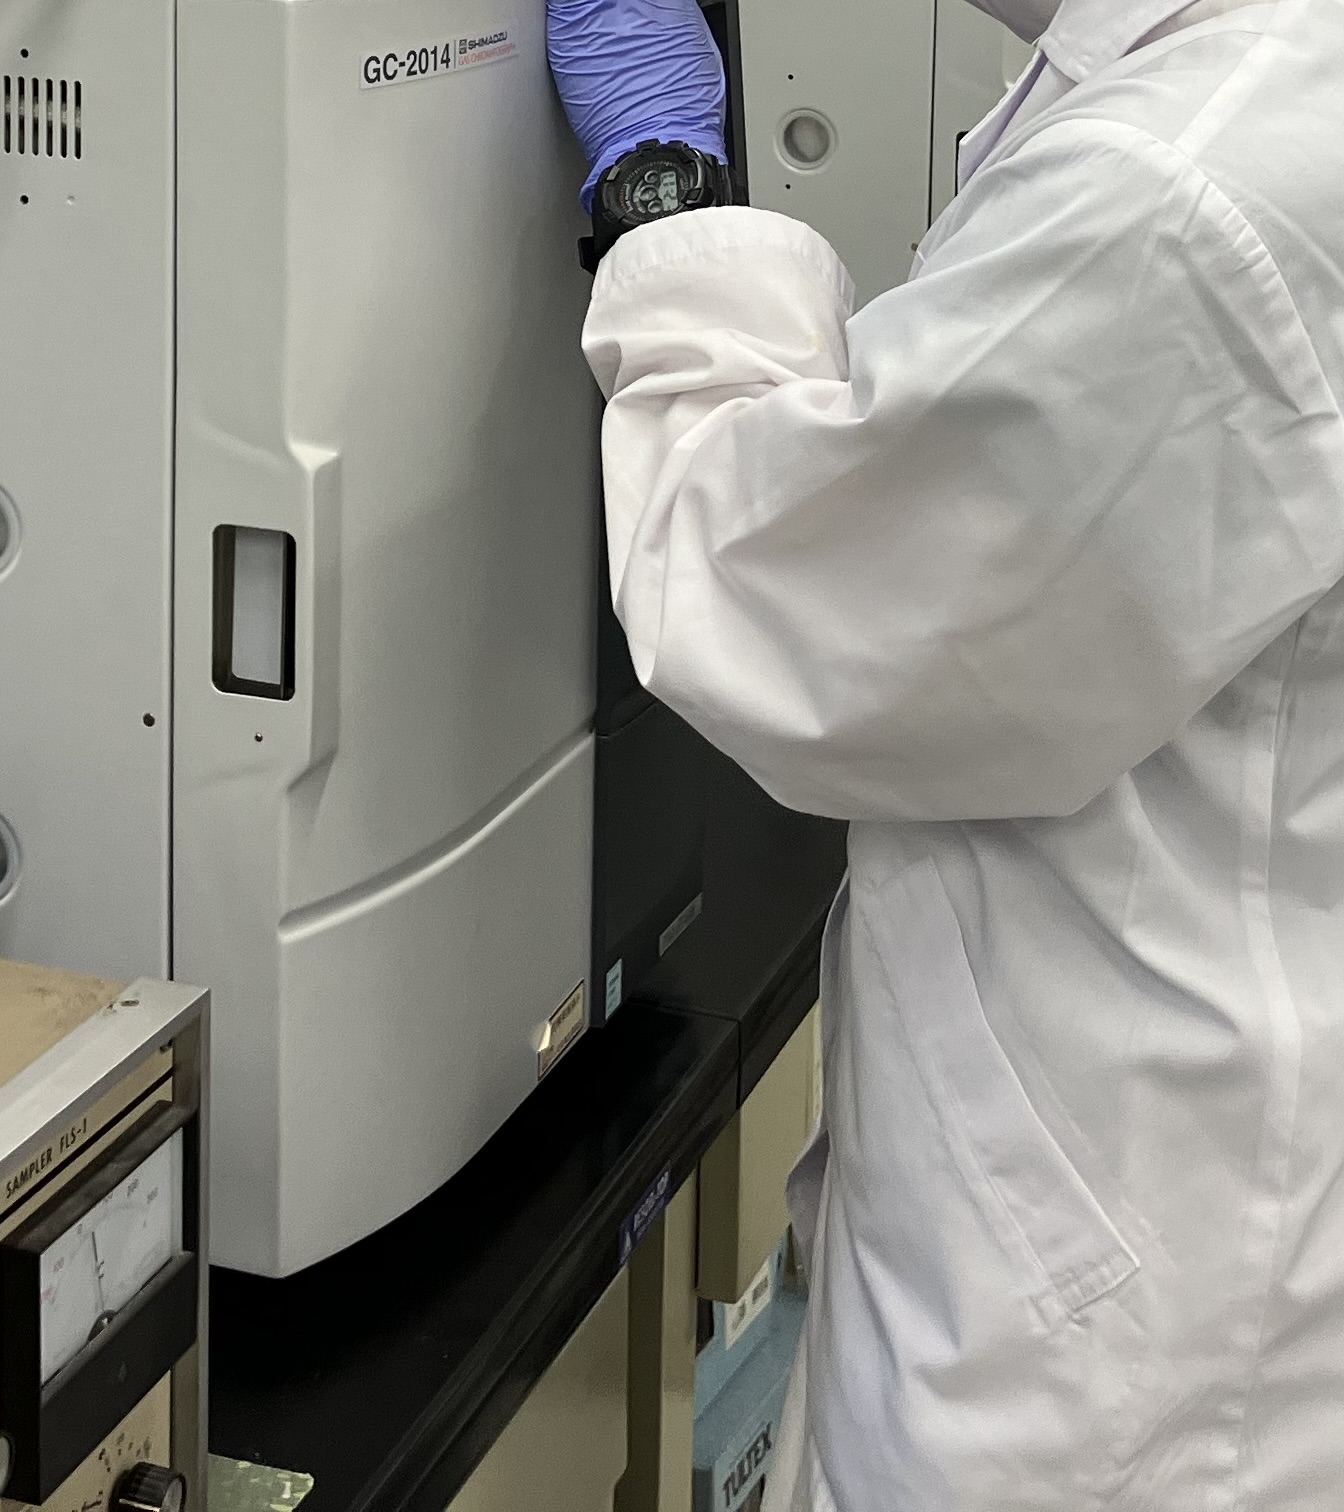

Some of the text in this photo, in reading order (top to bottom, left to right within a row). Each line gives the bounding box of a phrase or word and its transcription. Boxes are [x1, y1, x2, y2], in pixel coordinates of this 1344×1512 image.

[467, 31, 508, 50] SHIMADZU
[363, 43, 451, 83] GC-2014
[5, 1147, 54, 1201] SAMPLER
